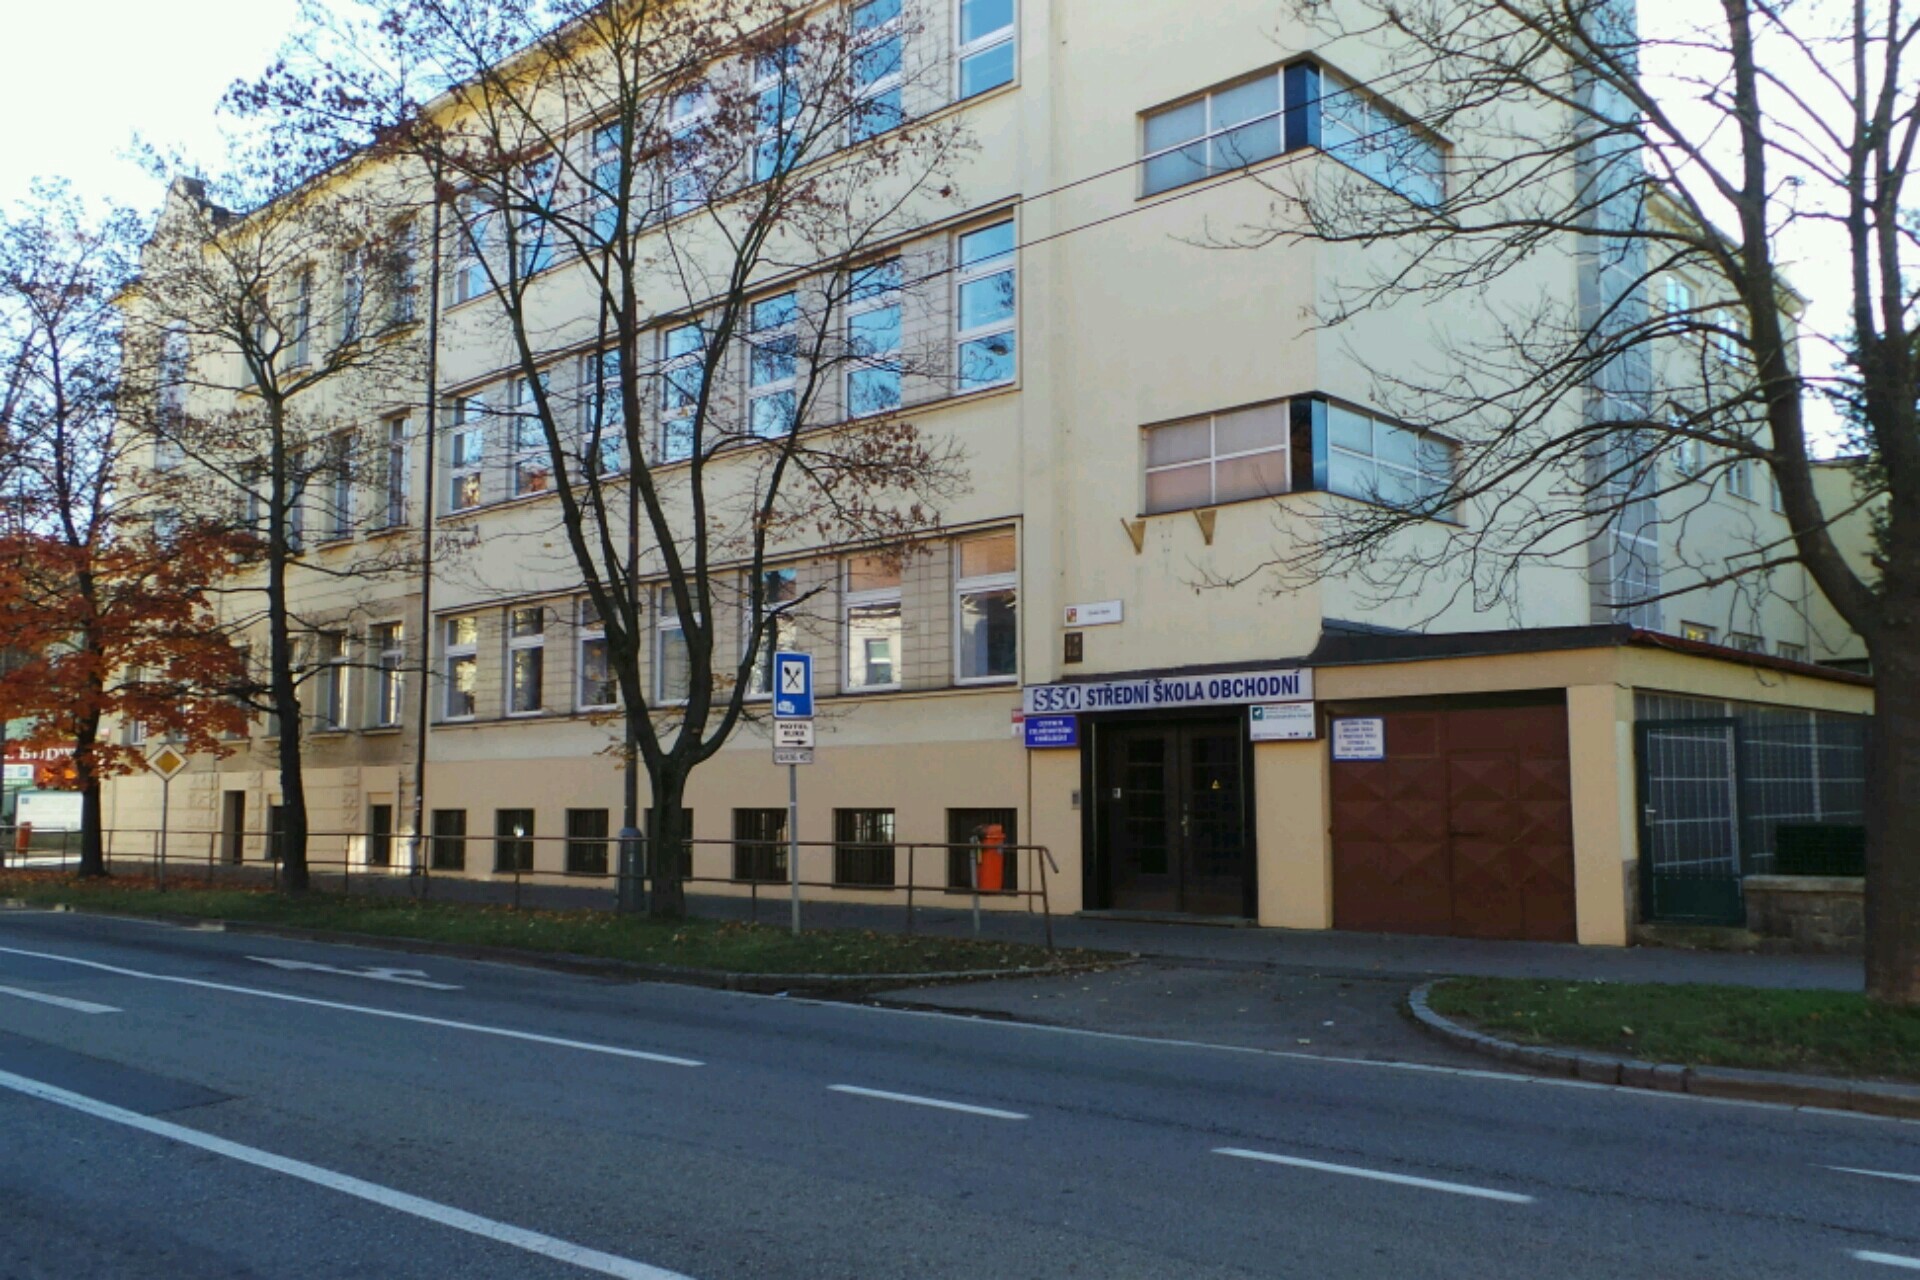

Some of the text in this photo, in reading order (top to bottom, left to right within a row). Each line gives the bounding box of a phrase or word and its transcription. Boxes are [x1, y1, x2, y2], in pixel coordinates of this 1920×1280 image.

[1034, 669, 1299, 711] SSO STŘEDNÍ ŠKOLA OBCHODNÍ
